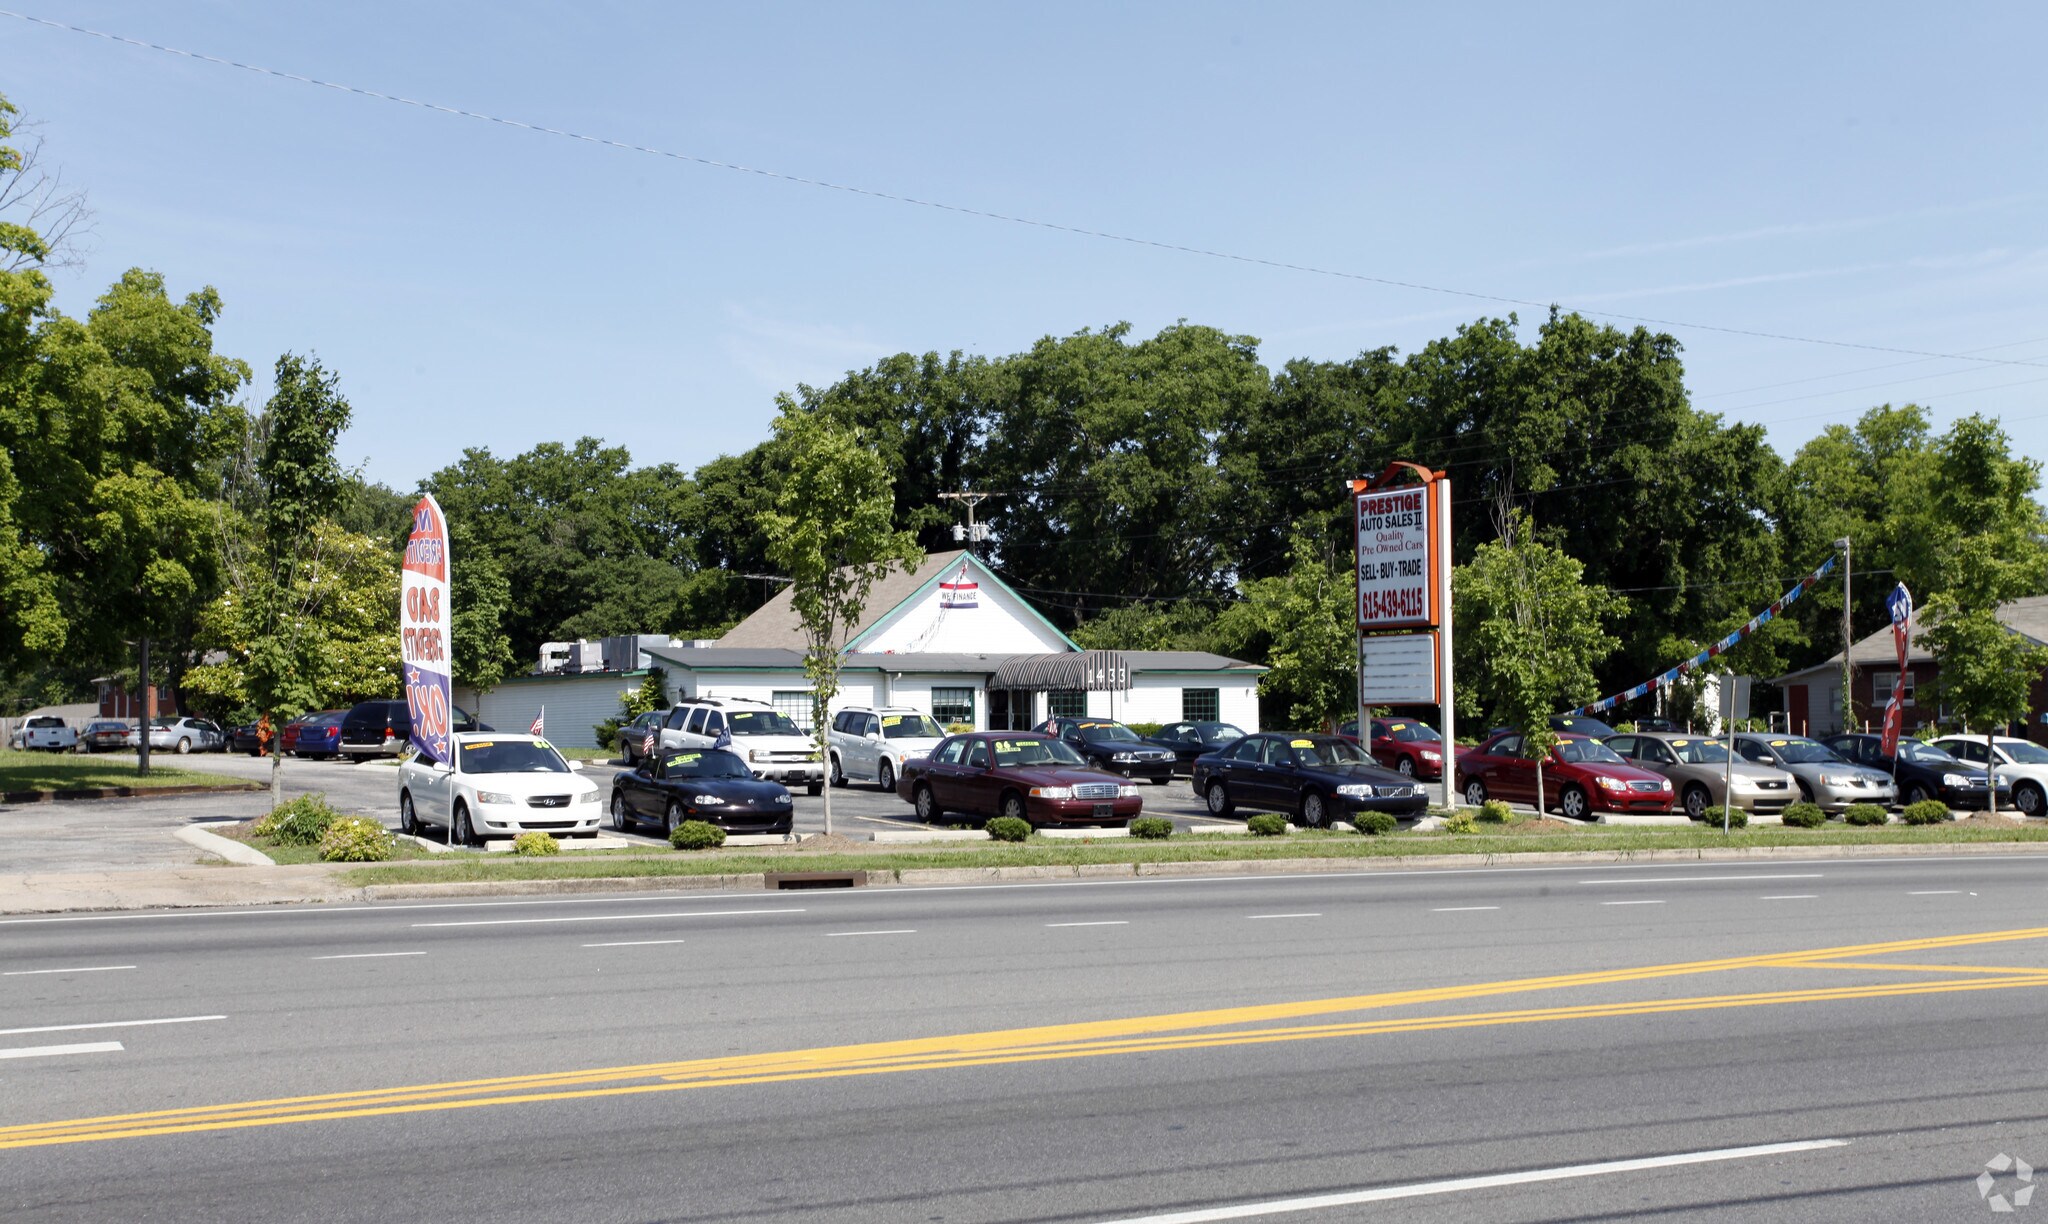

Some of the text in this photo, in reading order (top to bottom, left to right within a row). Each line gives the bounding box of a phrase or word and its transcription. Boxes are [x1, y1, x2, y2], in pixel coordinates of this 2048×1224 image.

[1360, 493, 1422, 517] PRESTIGE
[1360, 511, 1423, 532] AUTO SALES II
[1376, 530, 1404, 543] Quality
[1362, 540, 1424, 556] Pre Owned Cars
[1361, 558, 1422, 581] SELL BUY TRADE
[941, 591, 977, 601] WE FINANCE
[1362, 586, 1423, 620] 615-439-6115
[1088, 668, 1126, 683] 1433
